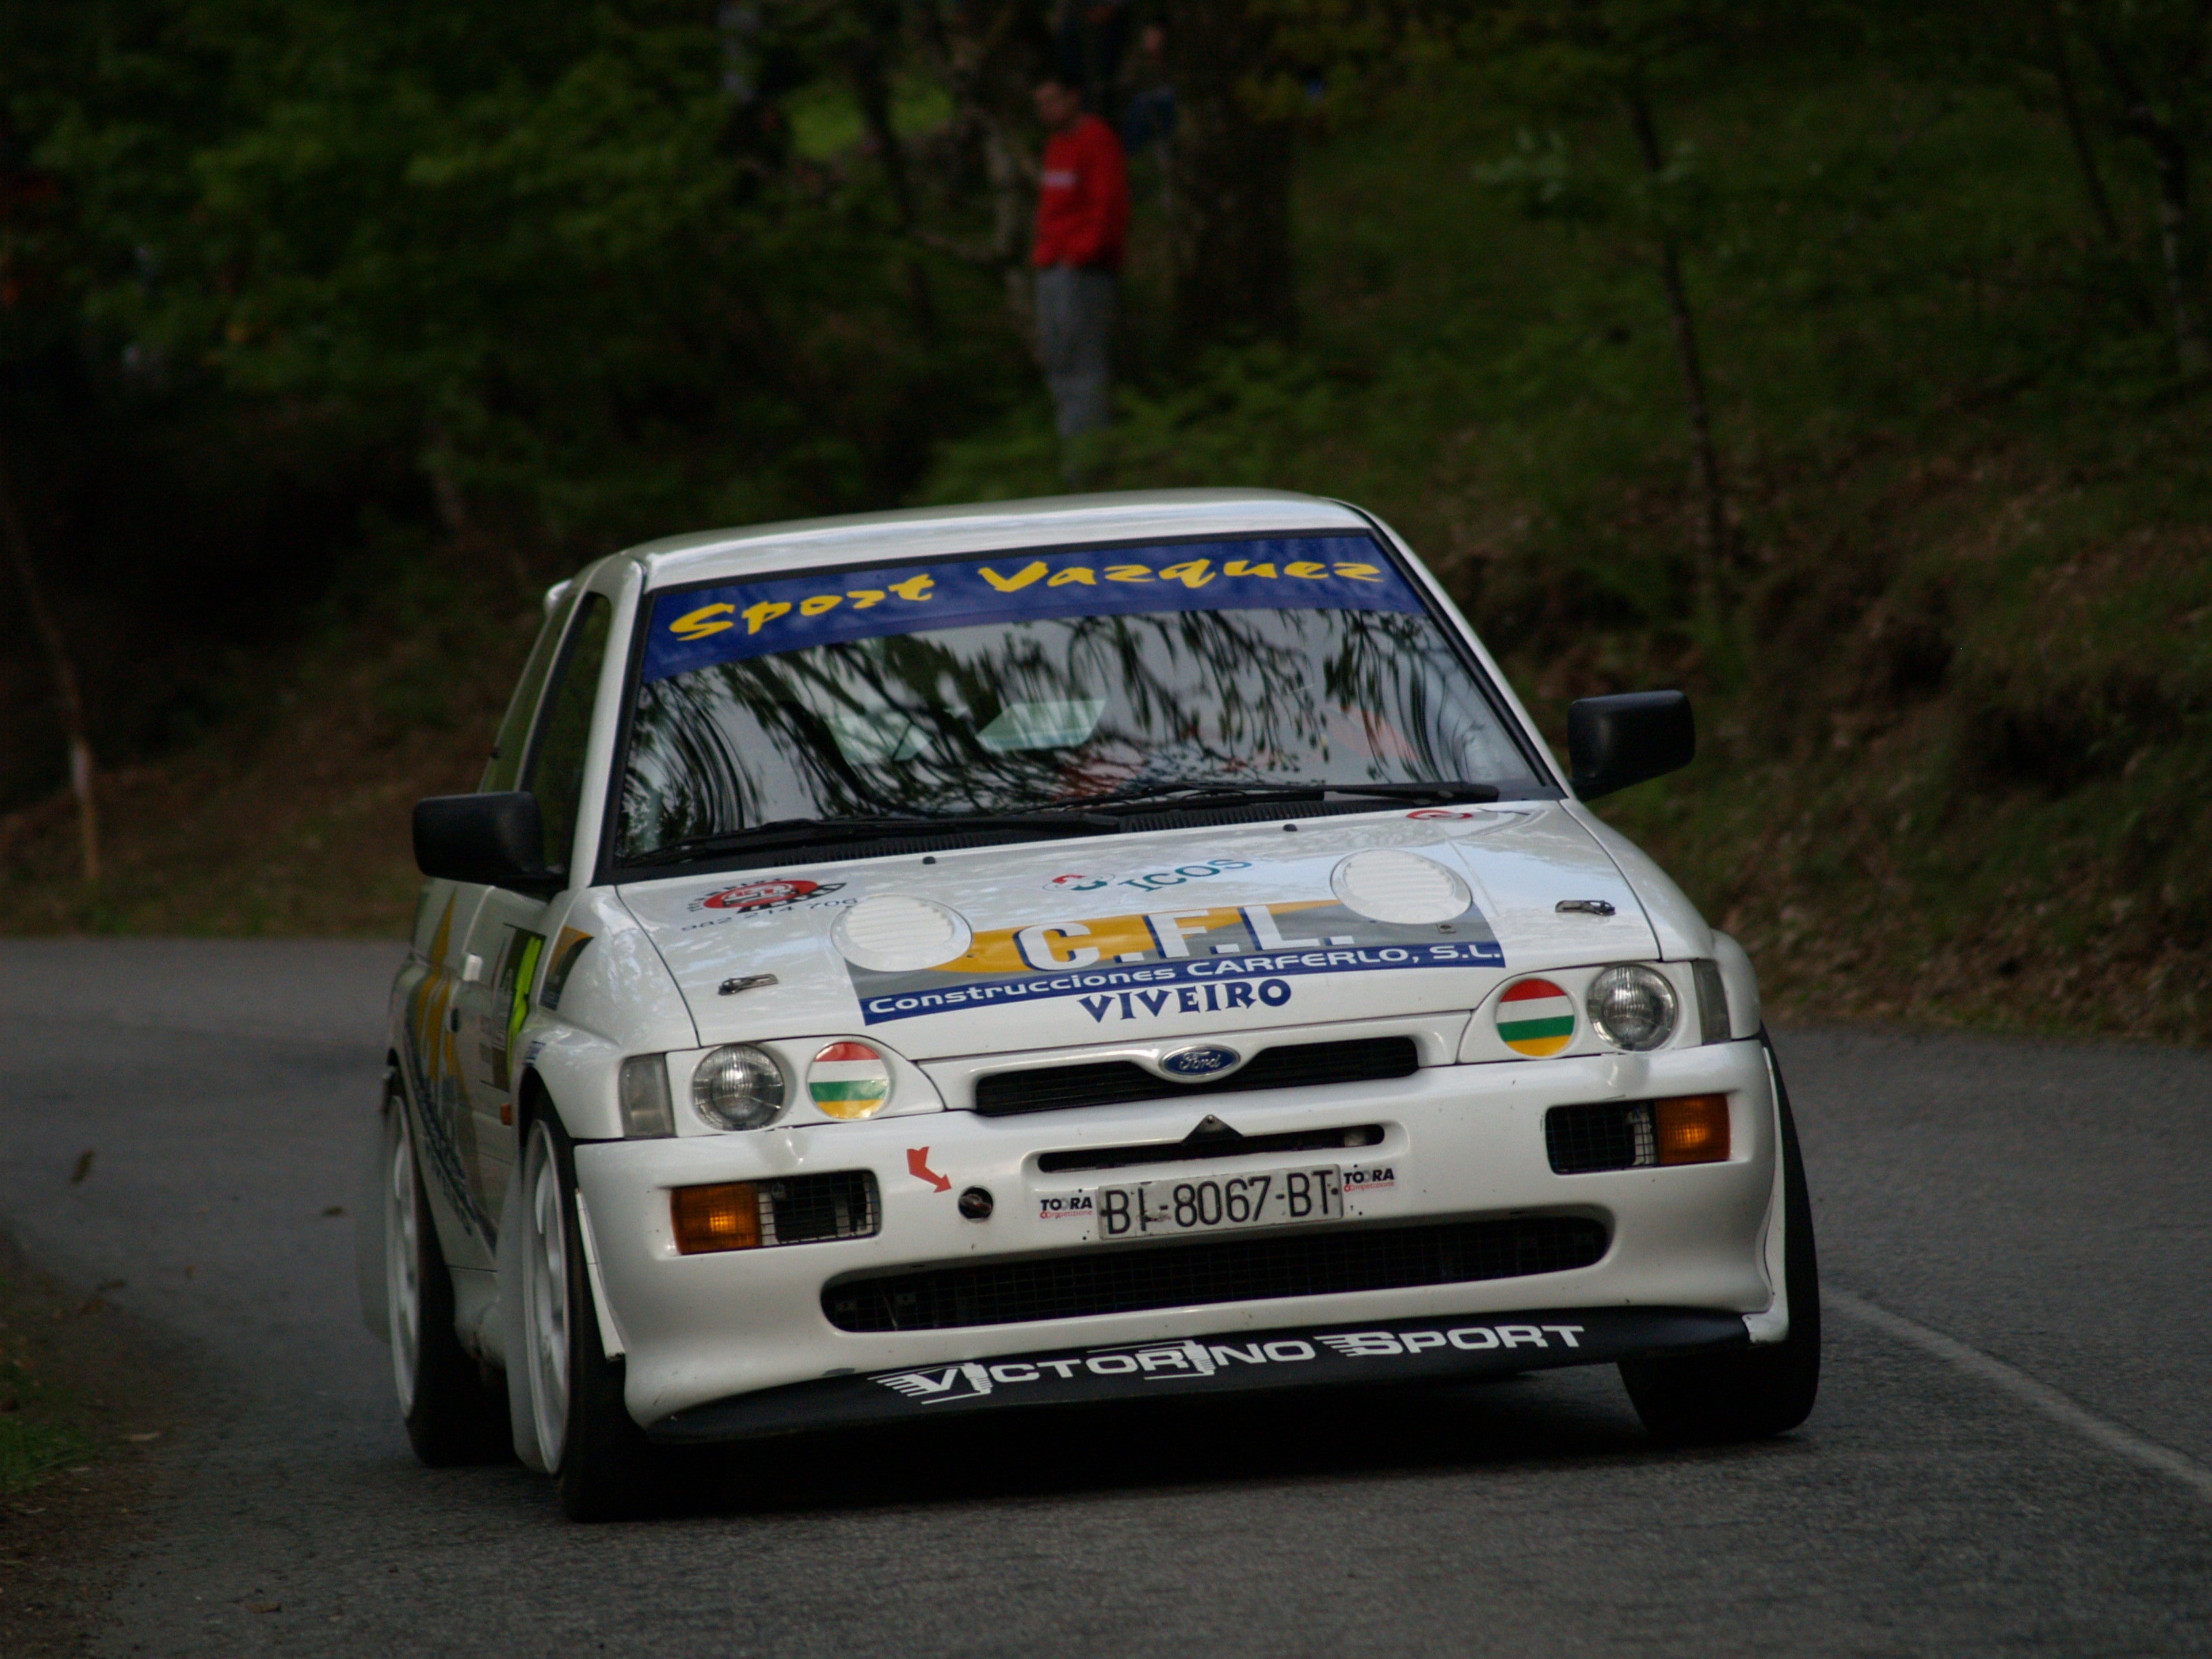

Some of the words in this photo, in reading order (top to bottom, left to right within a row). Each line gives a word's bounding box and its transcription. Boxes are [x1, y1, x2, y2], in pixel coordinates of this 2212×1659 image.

[668, 573, 937, 641] Sport
[978, 556, 1384, 593] Vazquez
[1118, 859, 1252, 892] ICOS
[1013, 905, 1354, 971] C.F.L.
[868, 967, 1176, 1014] Construcciones
[1187, 947, 1419, 977] CARFERLO,
[1433, 944, 1502, 960] S.L.
[1078, 978, 1292, 1023] VIVEIRO
[1179, 1051, 1221, 1070] Ford
[869, 1340, 1316, 1404] VICTORINO
[1315, 1324, 1584, 1357] SPORT
